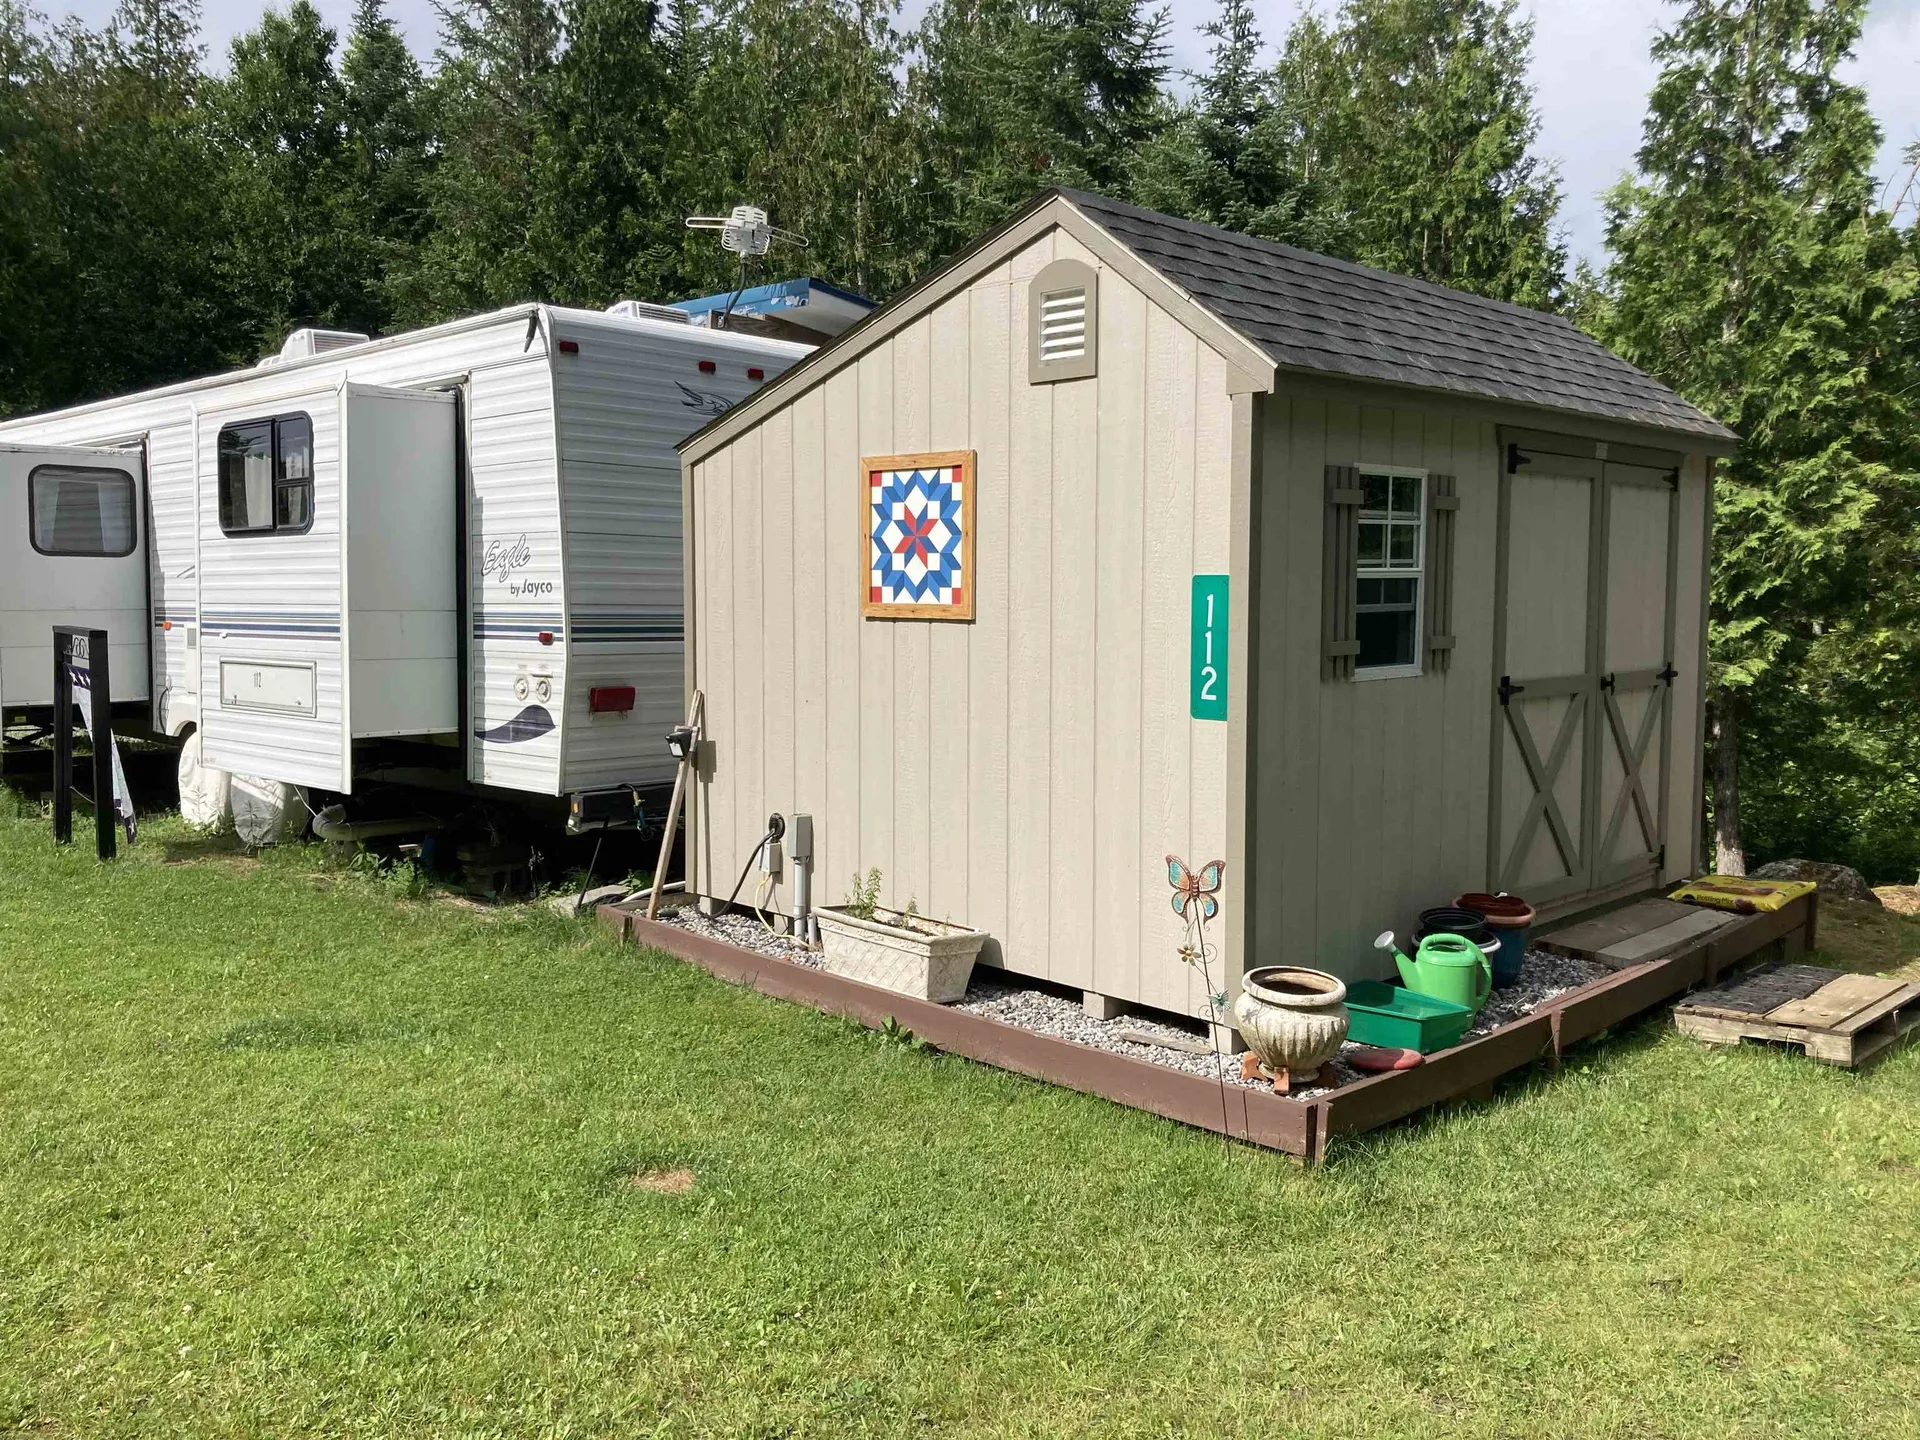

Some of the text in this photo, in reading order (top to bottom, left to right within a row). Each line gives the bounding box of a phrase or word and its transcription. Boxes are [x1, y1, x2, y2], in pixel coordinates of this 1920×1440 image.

[481, 533, 531, 583] Eagle
[510, 579, 553, 597] by Jayco
[1200, 593, 1217, 700] 112
